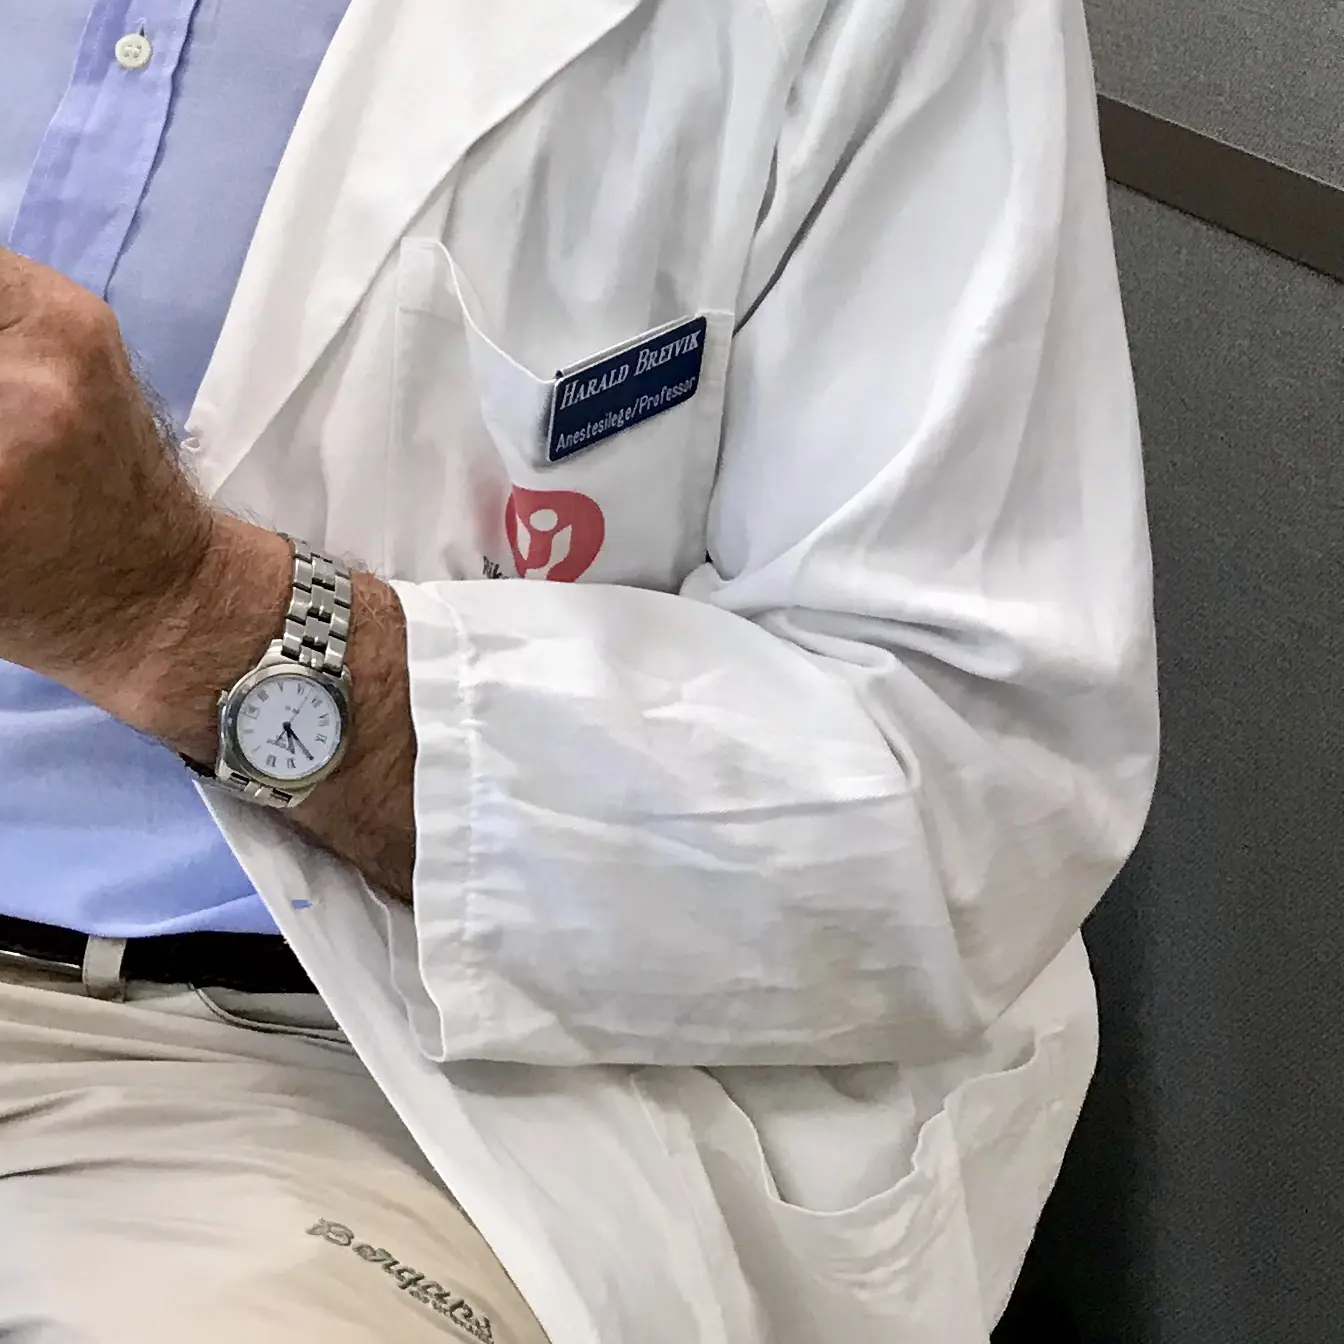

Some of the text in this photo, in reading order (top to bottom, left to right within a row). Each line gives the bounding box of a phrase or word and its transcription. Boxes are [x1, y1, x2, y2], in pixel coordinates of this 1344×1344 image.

[560, 329, 702, 410] HARALD BREIVIK
[556, 376, 696, 453] Anestesilege/Professor
